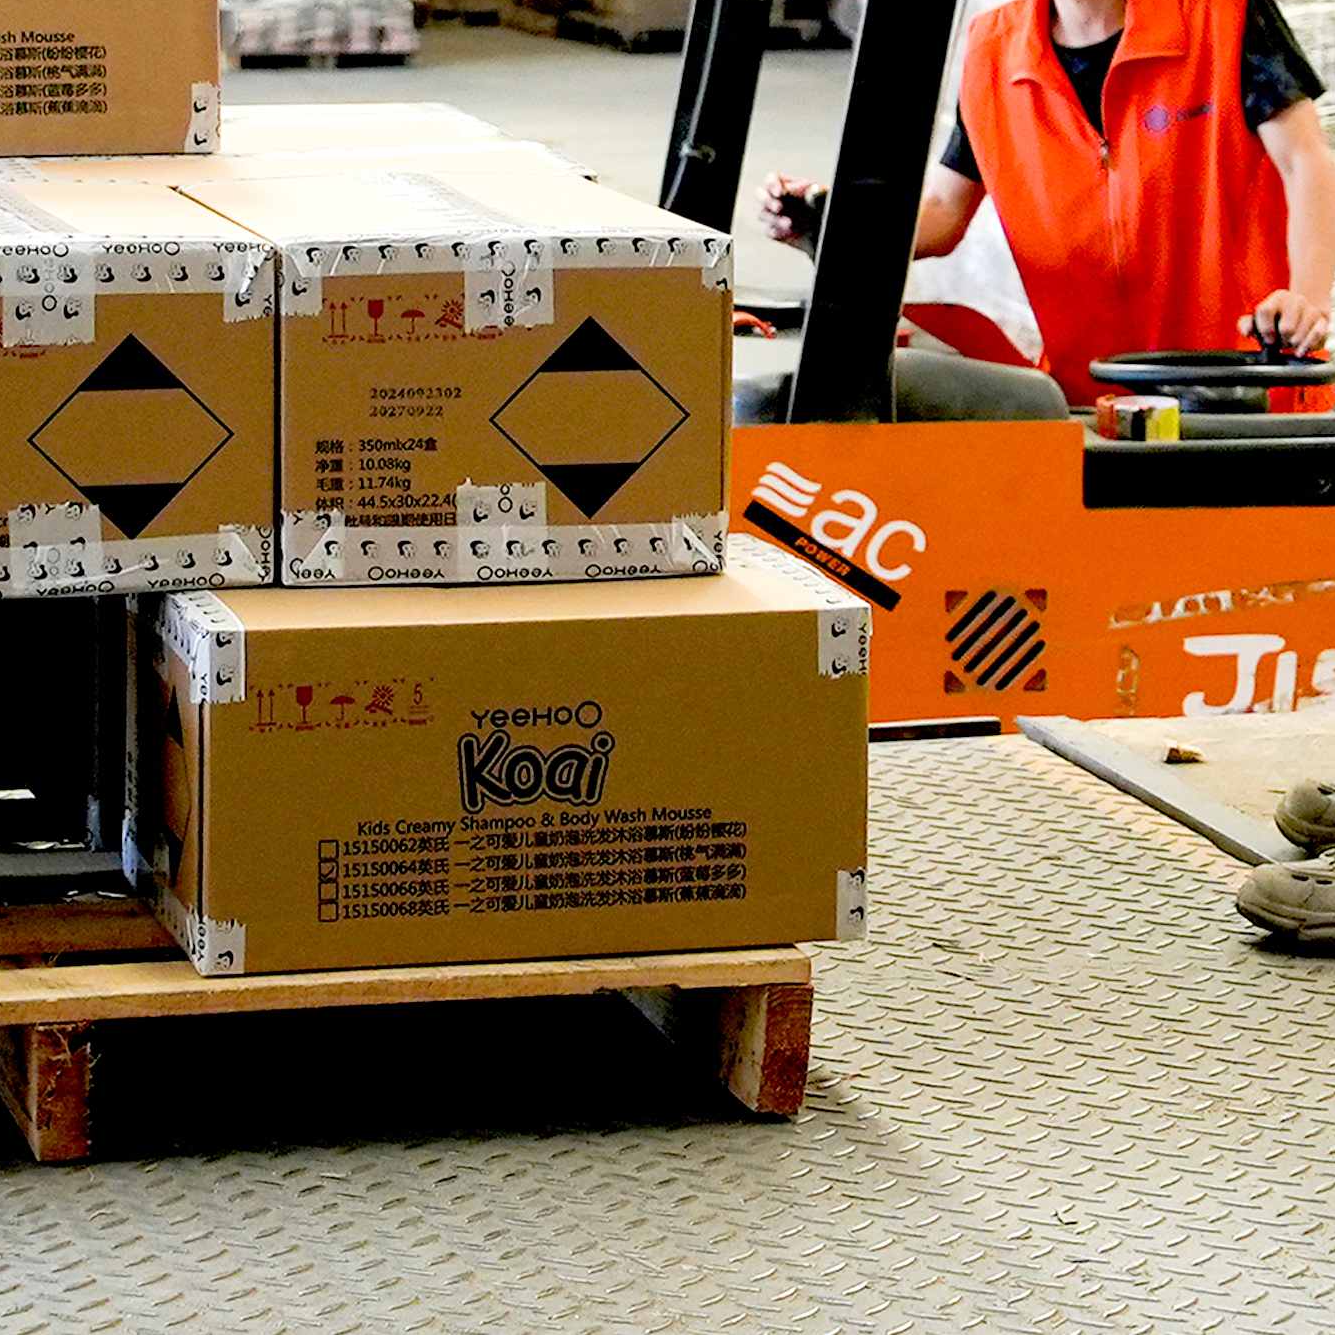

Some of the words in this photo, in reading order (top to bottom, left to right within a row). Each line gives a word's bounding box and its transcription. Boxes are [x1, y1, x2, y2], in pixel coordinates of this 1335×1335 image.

[21, 31, 76, 43] Mousse
[358, 457, 412, 473] 10.08kg
[358, 476, 412, 493] 11.74kg
[794, 536, 852, 577] POWER
[458, 729, 616, 813] Koai
[357, 821, 391, 836] Kids
[395, 819, 455, 836] Creamy
[460, 815, 536, 833] Shampoo
[540, 812, 554, 826] &
[560, 810, 599, 829] Body
[605, 808, 647, 824] Wash
[651, 807, 713, 821] Mousse
